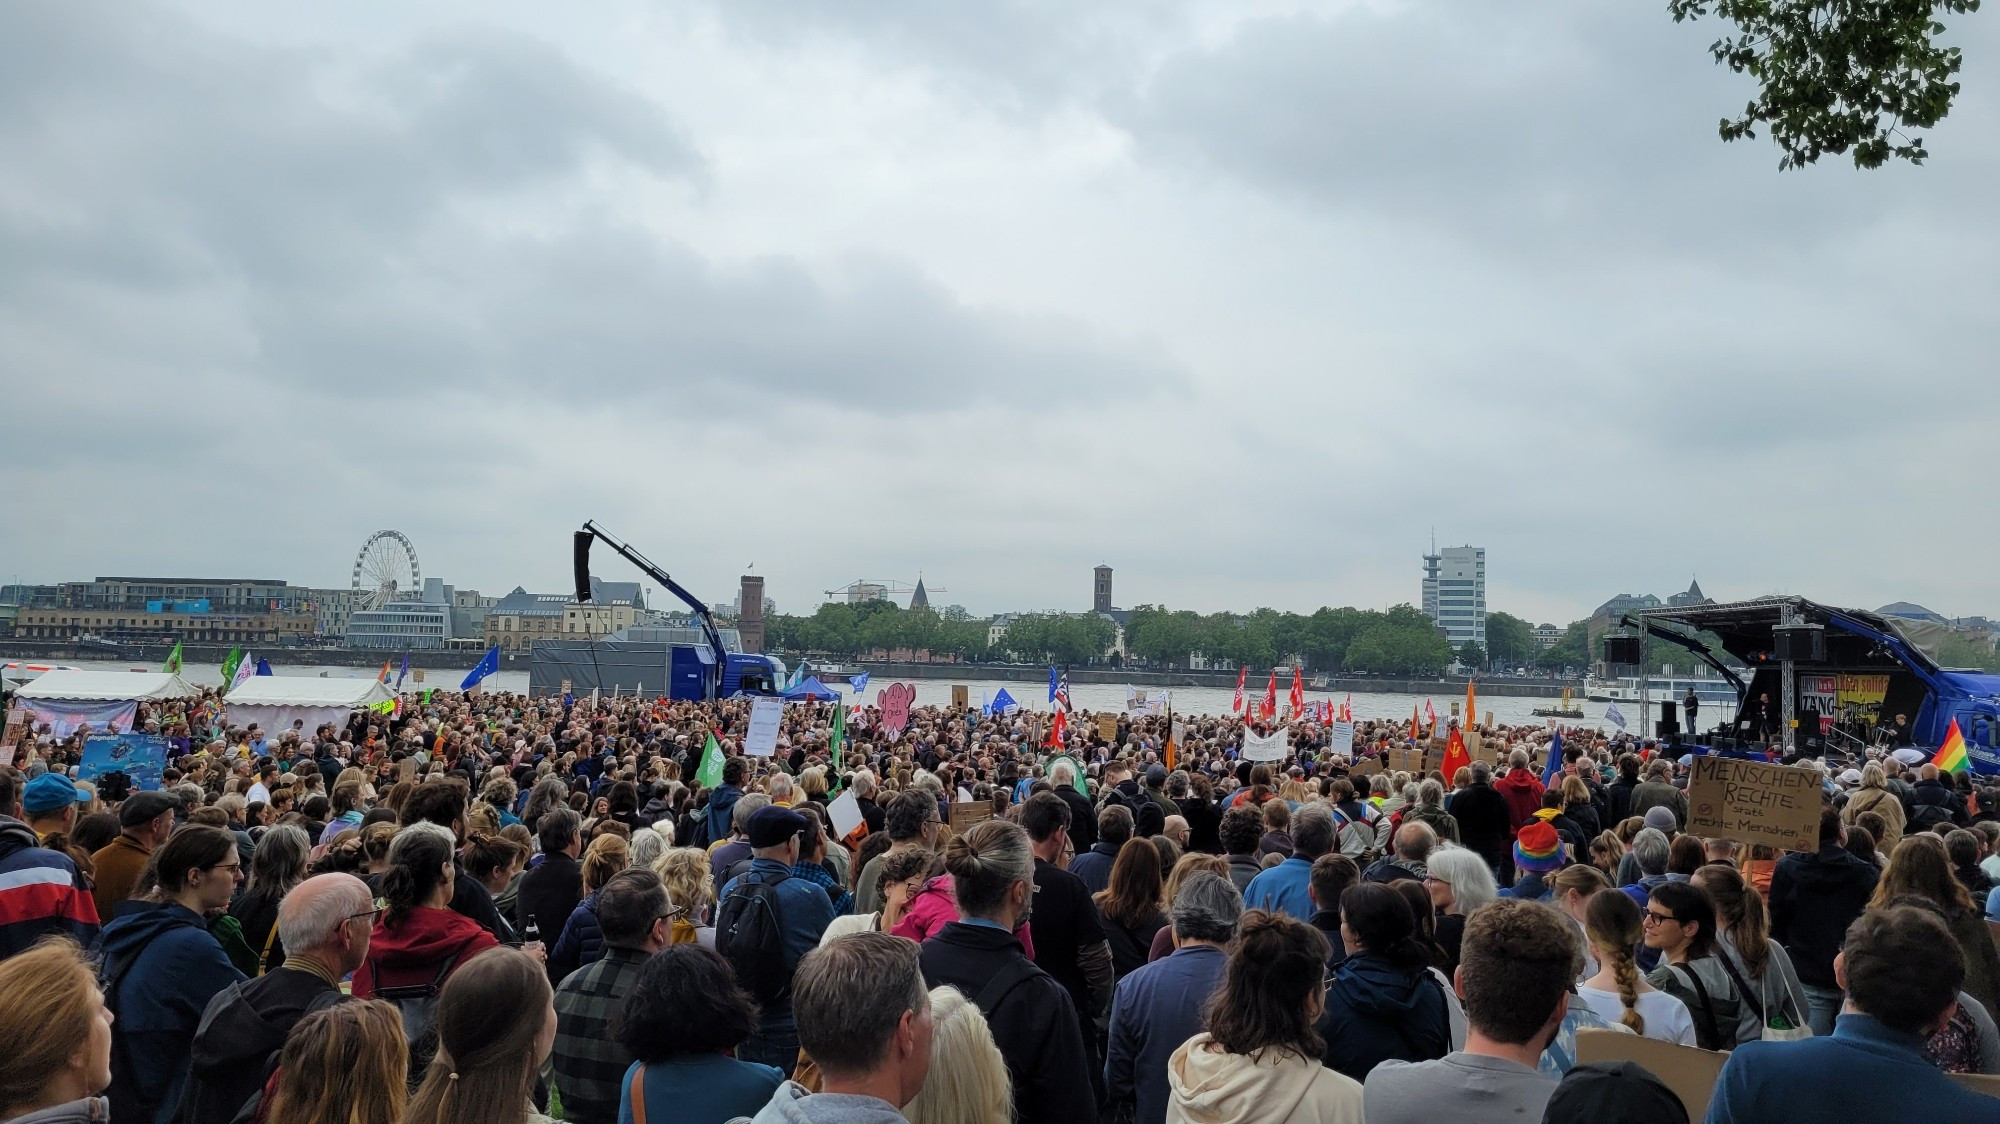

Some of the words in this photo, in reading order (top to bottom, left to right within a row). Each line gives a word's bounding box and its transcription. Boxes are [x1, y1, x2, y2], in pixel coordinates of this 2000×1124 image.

[1695, 758, 1821, 789] MENSCHEN-
[1733, 806, 1765, 817] statt
[1693, 817, 1733, 830] rechte
[1738, 819, 1799, 838] Menschen
